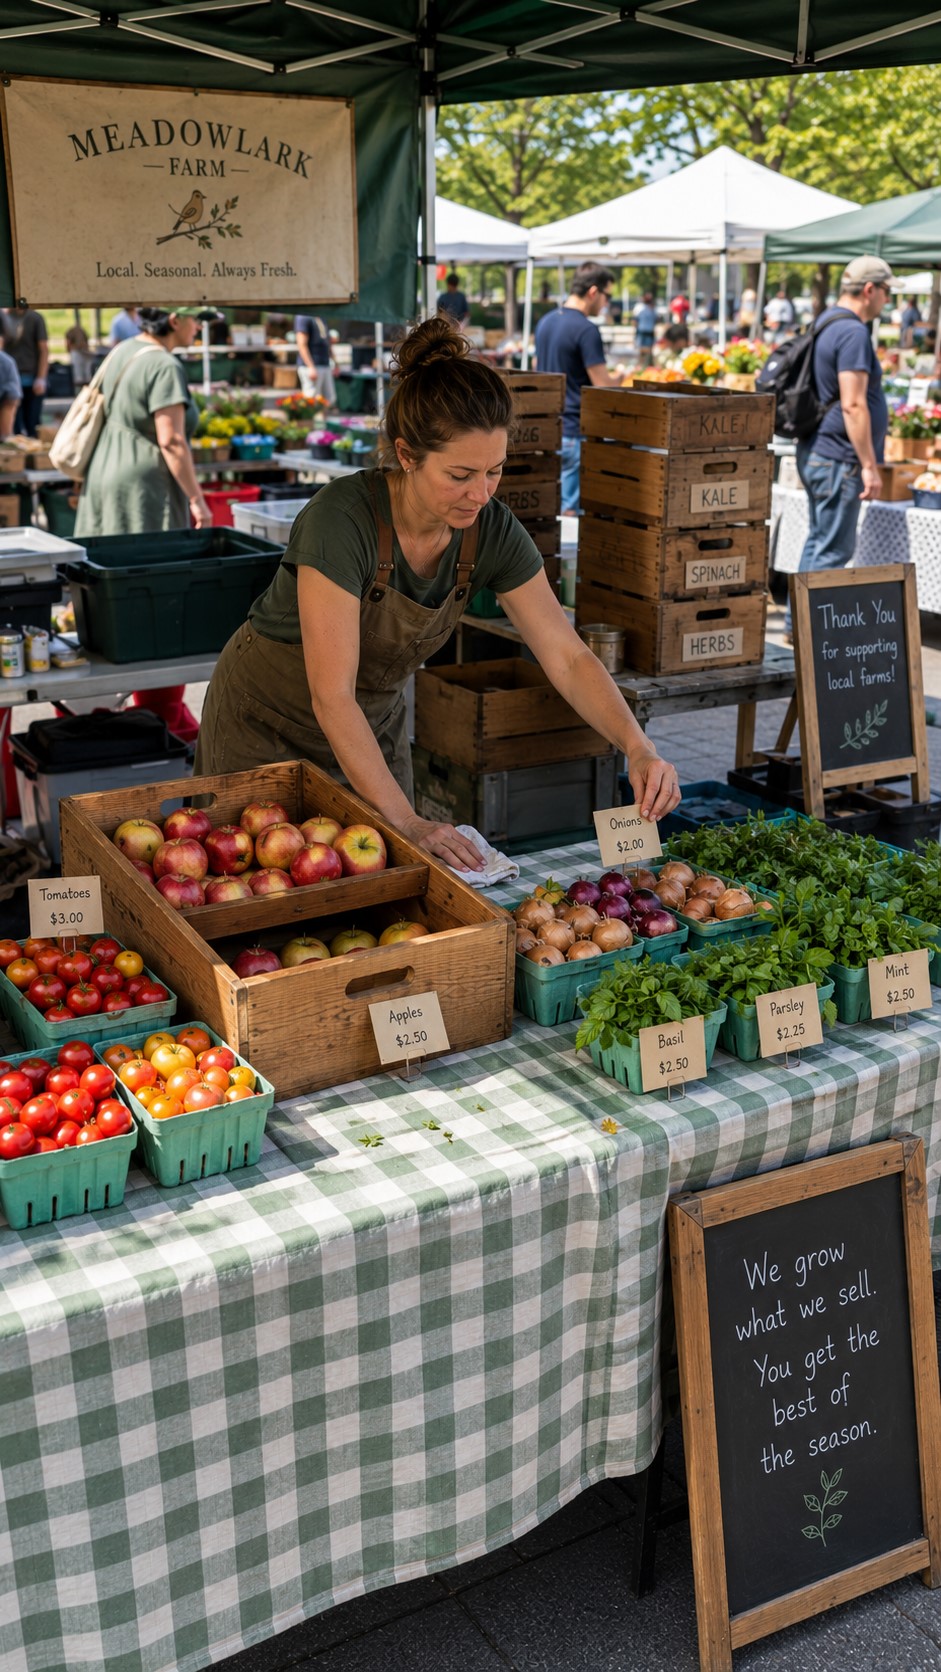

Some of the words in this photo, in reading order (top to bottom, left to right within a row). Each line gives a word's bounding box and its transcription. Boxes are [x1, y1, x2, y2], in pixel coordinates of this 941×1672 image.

[67, 119, 313, 179] MEADOWLARK
[169, 157, 226, 177] FARM
[96, 261, 139, 278] Local.
[144, 262, 206, 278] Seasonal.
[211, 262, 256, 281] Always
[260, 262, 297, 278] Fresh.
[702, 486, 737, 507] KALE
[691, 563, 740, 584] SPINACH
[817, 602, 866, 629] Thank
[872, 599, 896, 624] You
[691, 634, 735, 655] HERBS
[822, 641, 839, 660] for
[846, 638, 898, 662] supporting
[828, 670, 854, 690] local
[860, 665, 895, 687] farms!
[610, 817, 642, 830] Onions
[617, 838, 643, 853] $2.00
[39, 887, 90, 901] Tomatoes
[50, 912, 83, 925] $3.00
[885, 963, 909, 979] Mint
[886, 988, 915, 1004] $2.50
[389, 1006, 423, 1025] Apples
[770, 999, 805, 1017] Parsley
[396, 1030, 428, 1048] $2.50
[658, 1030, 684, 1049] Basil
[776, 1023, 805, 1041] $2.25
[659, 1057, 688, 1076] $2.50
[743, 1251, 782, 1290] We
[795, 1243, 845, 1287] grow
[736, 1300, 787, 1341] what
[799, 1295, 827, 1319] we
[839, 1269, 877, 1305] sell.
[754, 1353, 792, 1387] You
[804, 1335, 836, 1381] get
[847, 1323, 880, 1353] the
[772, 1387, 817, 1427] best
[830, 1372, 851, 1407] of
[760, 1443, 796, 1474] the
[808, 1420, 877, 1457] season.
